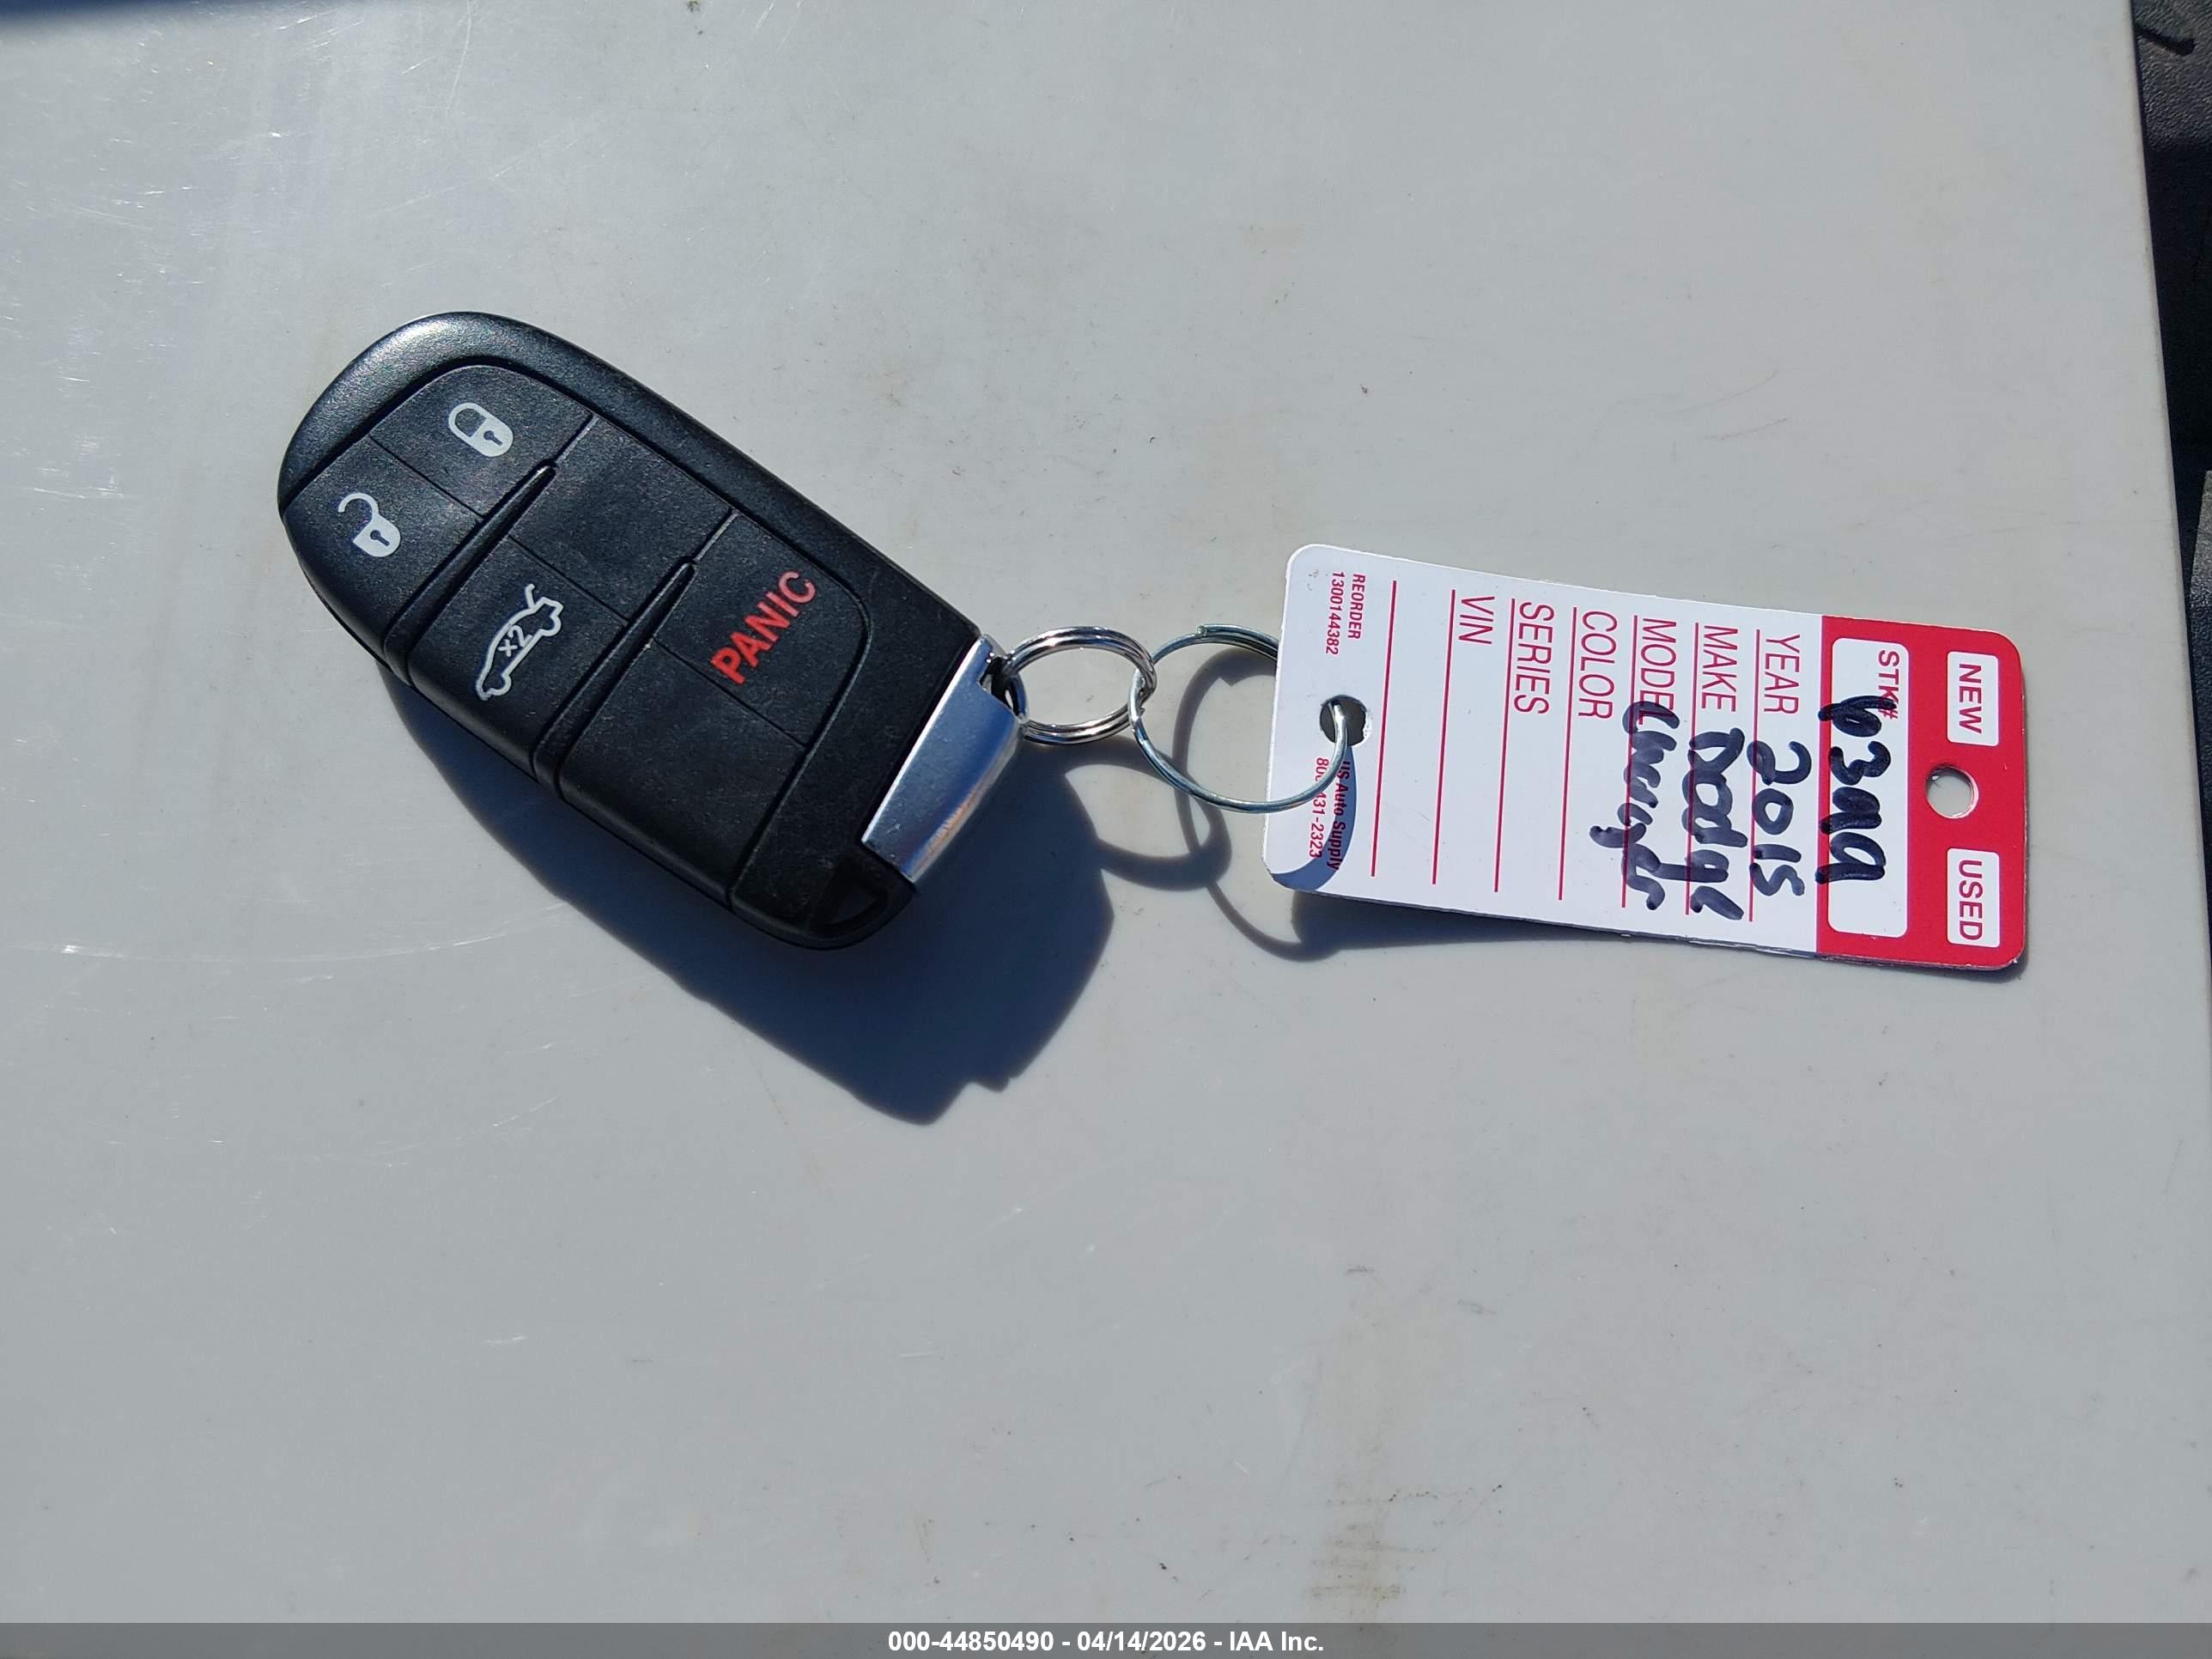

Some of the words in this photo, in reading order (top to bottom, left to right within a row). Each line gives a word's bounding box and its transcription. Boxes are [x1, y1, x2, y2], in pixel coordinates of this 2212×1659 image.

[709, 570, 817, 684] PANIC
[1325, 571, 1346, 655] 1300144382
[1352, 573, 1366, 640] REORDER
[1457, 595, 1496, 646] VIN
[1513, 601, 1555, 714] SERIES
[1577, 610, 1619, 720] COLOR
[1638, 617, 1677, 725] MODEL
[1701, 625, 1739, 713] MAKE
[1764, 633, 1801, 714] YEAR
[1958, 663, 1984, 734] NEW
[1334, 782, 1349, 816] Auto
[1649, 727, 1748, 920] Dodge
[1747, 740, 1812, 896] 2015
[1327, 820, 1346, 871] Supply
[1958, 860, 1984, 940] USED
